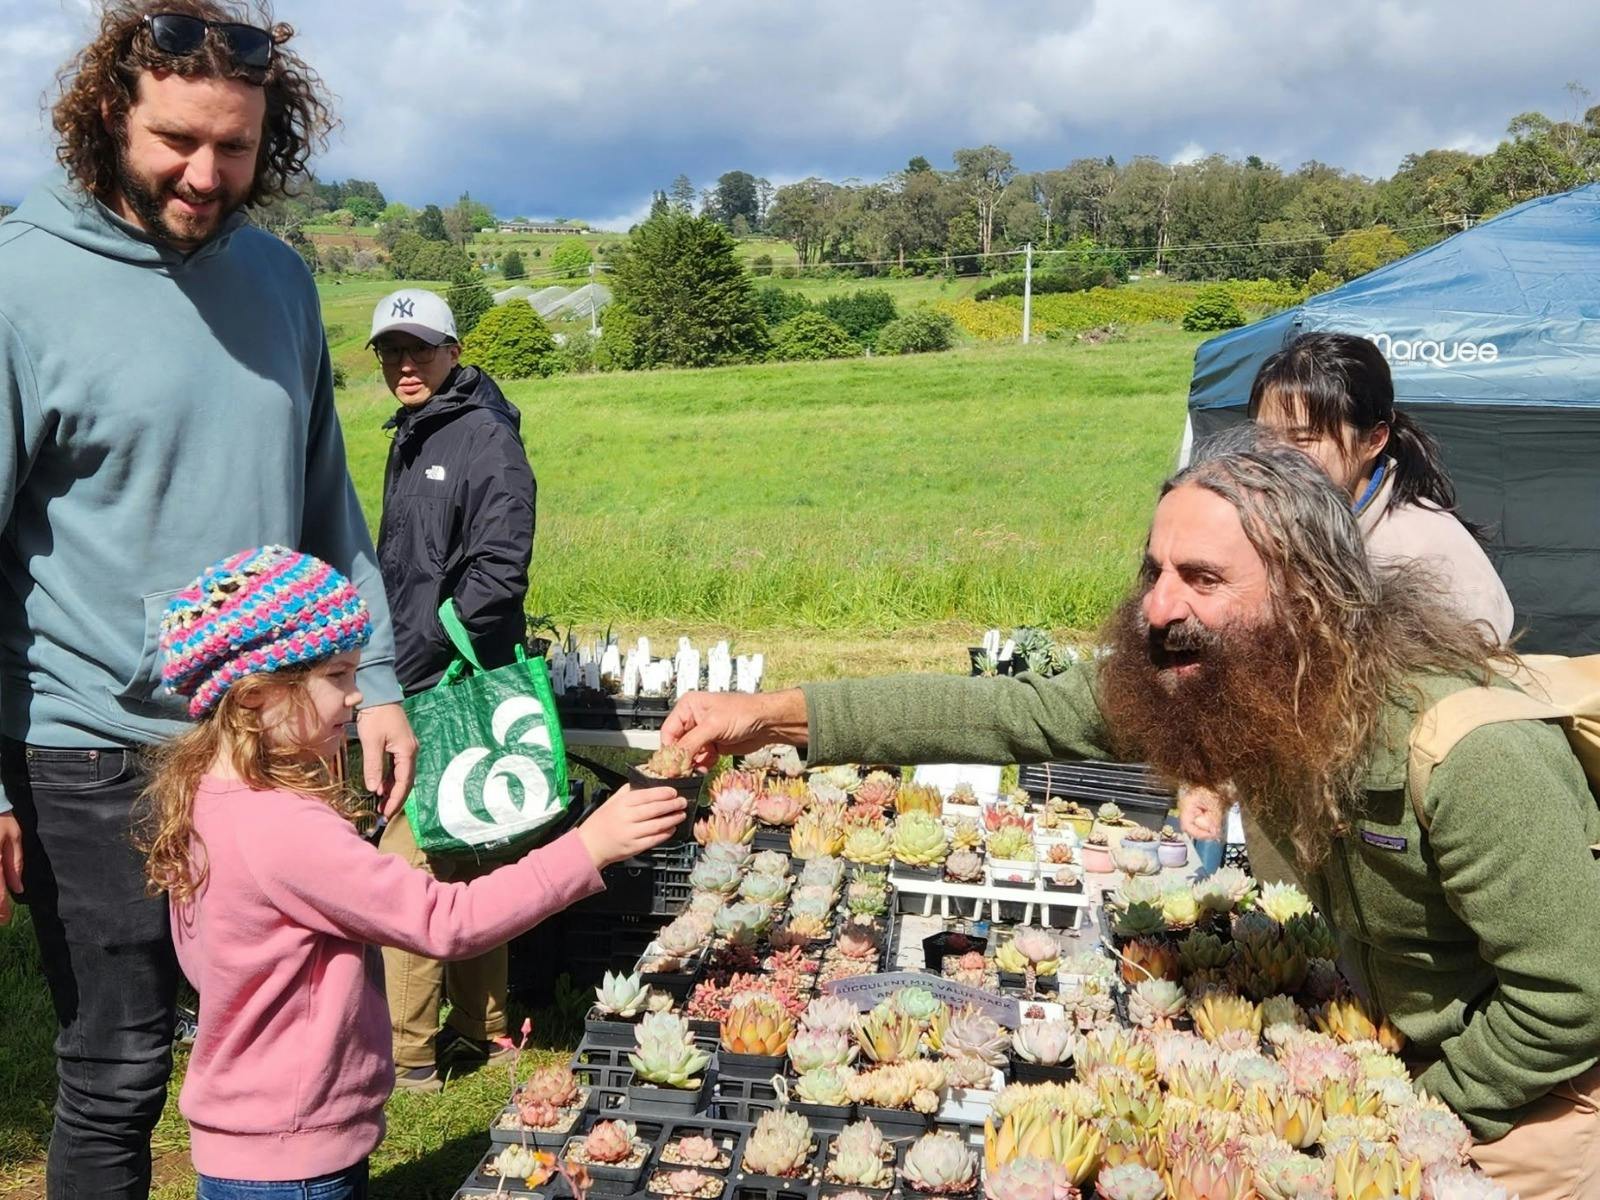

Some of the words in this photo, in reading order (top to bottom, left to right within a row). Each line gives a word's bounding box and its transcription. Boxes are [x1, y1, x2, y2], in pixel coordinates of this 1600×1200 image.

[391, 297, 415, 318] NY
[836, 979, 906, 994] SUCCULENT
[909, 979, 934, 988] MIX
[938, 984, 976, 999] VALUE
[979, 996, 1013, 1010] PACK
